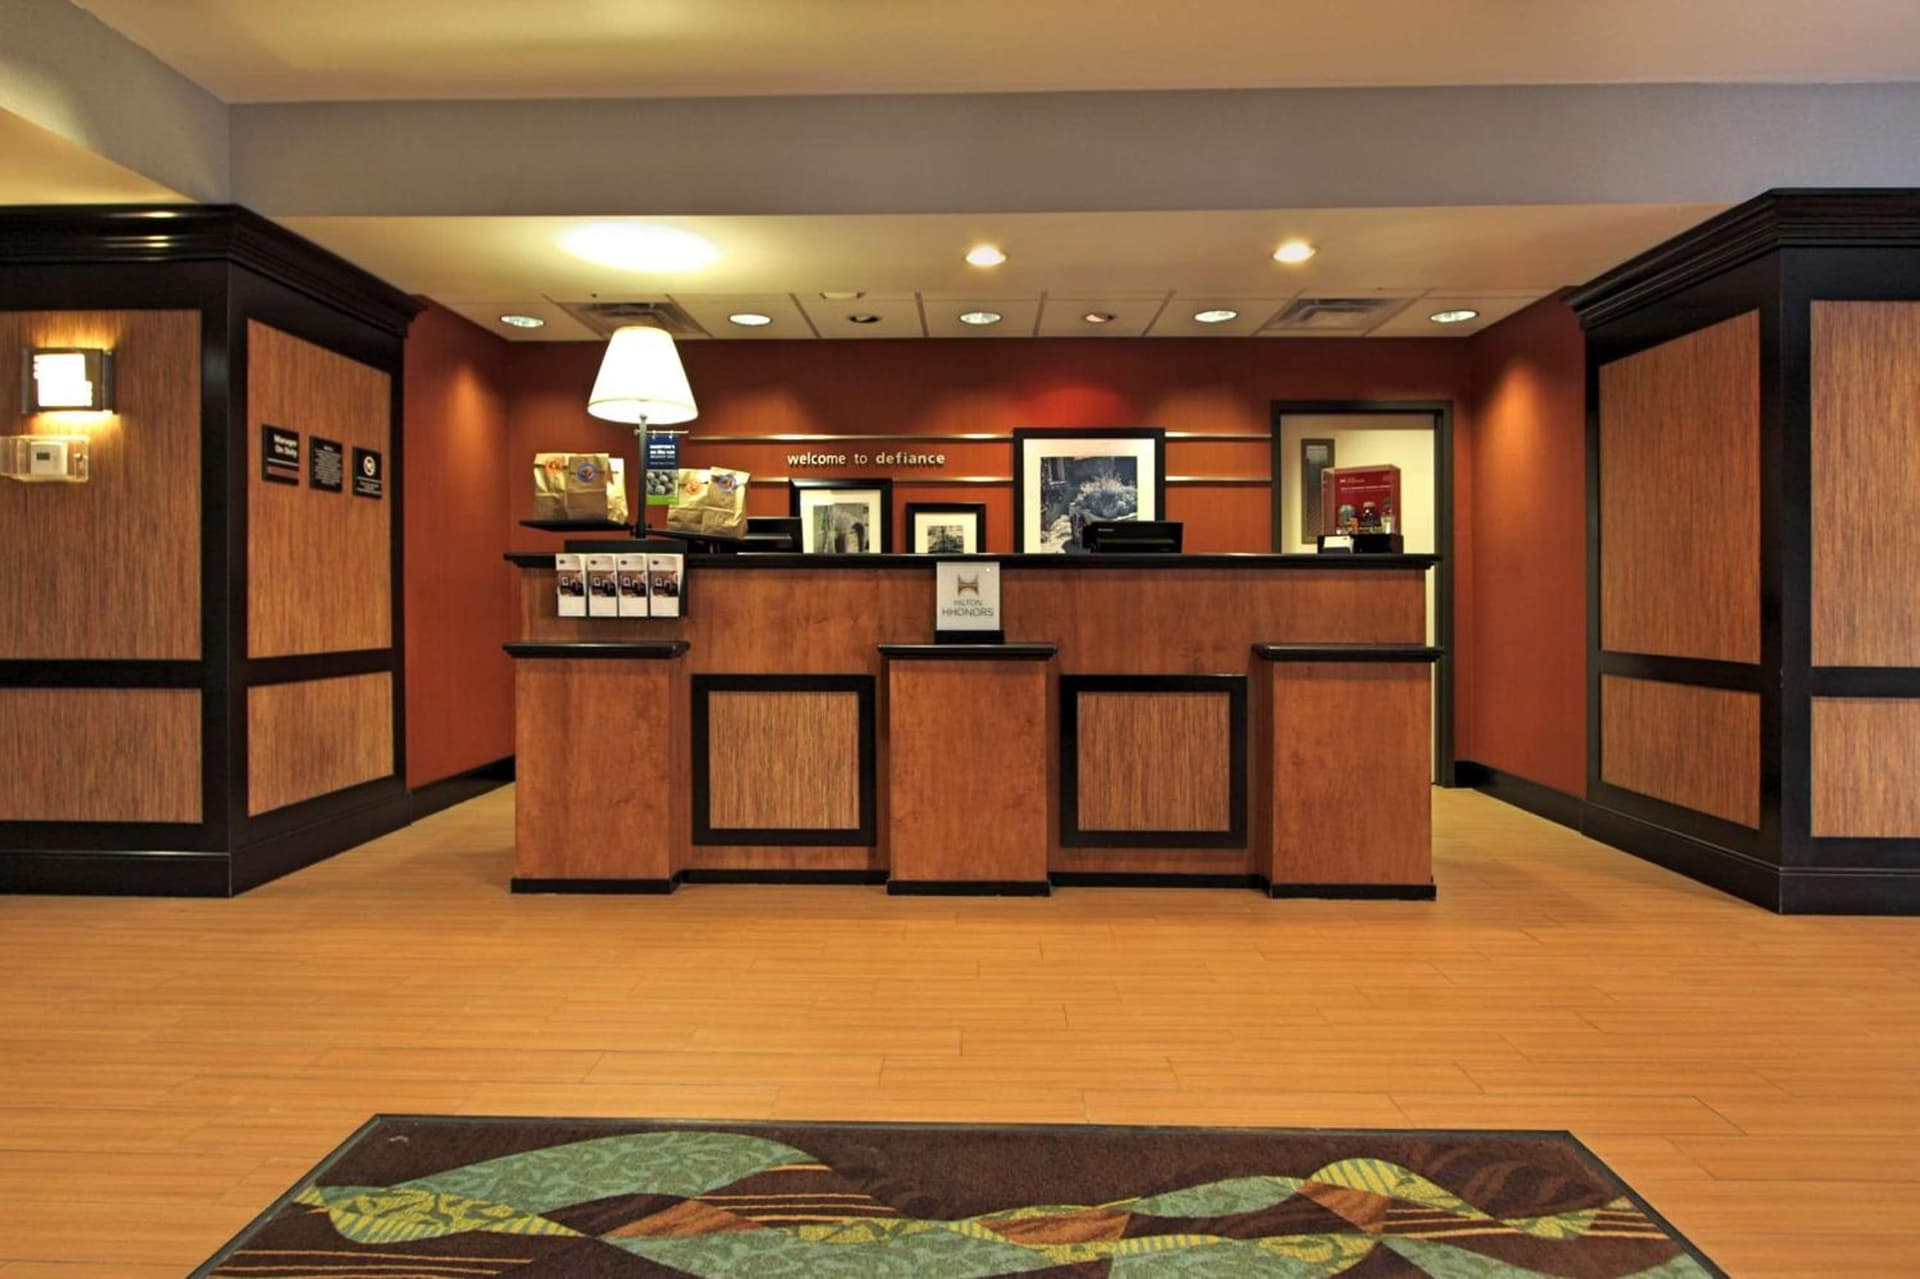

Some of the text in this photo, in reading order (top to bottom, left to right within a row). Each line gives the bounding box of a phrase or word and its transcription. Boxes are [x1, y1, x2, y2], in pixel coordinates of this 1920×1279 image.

[787, 452, 945, 465] welcome to defiance
[953, 599, 983, 607] HILTON
